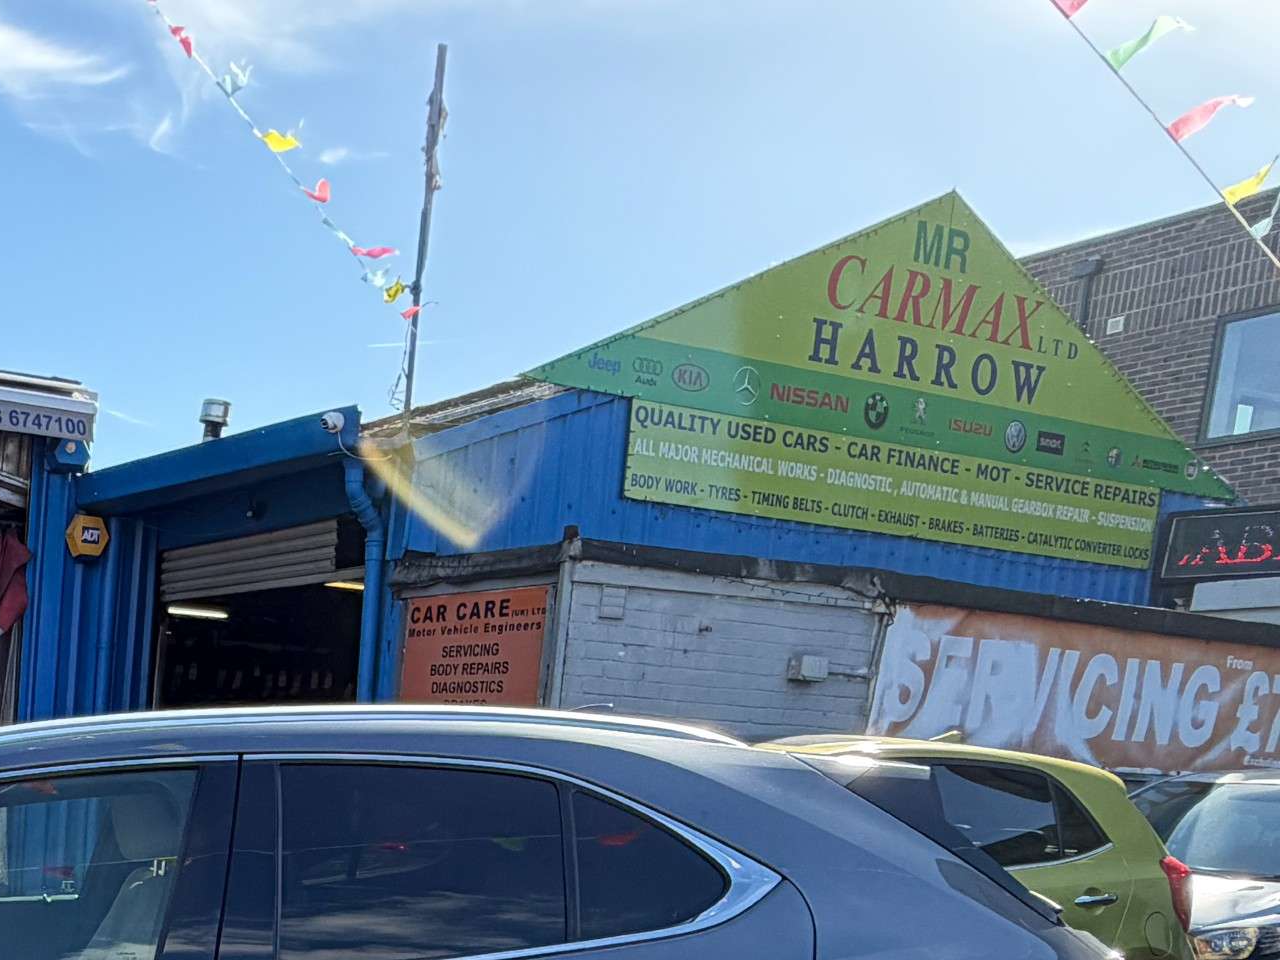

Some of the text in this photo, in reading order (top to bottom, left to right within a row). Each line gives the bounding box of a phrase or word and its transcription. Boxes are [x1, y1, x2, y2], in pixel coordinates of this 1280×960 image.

[913, 220, 970, 274] MR
[827, 254, 1079, 360] CARMAX LTD
[588, 353, 621, 376] Jeep
[808, 317, 1047, 405] HARROW
[634, 374, 658, 387] Audi
[677, 368, 704, 388] KIA
[771, 382, 850, 414] NISSAN
[8, 409, 87, 436] 6747100
[949, 418, 993, 437] ISUZU
[634, 405, 721, 435] QUALITY
[727, 420, 776, 444] USED
[782, 430, 830, 454] CARS
[847, 441, 881, 463] CAR
[886, 448, 960, 476] FINANCE
[976, 463, 1011, 483] MOT
[1024, 472, 1090, 497] SERVICE
[1093, 483, 1157, 508] REPAIRS
[634, 437, 656, 457] ALL
[659, 441, 699, 464] MAJOR
[701, 448, 774, 475] MECHANICAL
[777, 460, 818, 482] WORKS
[900, 480, 959, 503] AUTOMATIC
[960, 490, 968, 505] &
[970, 492, 1009, 512] MANUAL
[1011, 498, 1055, 517] GEARBOX
[1055, 505, 1089, 524] REPAIR
[1097, 511, 1154, 533] SUSPENSION
[630, 473, 662, 490] BODY
[664, 476, 698, 496] WORK
[708, 484, 741, 502] TYRES
[751, 490, 790, 510] TIMING
[792, 496, 822, 514] BELTS
[831, 502, 869, 521] CLUTCH
[877, 509, 920, 528] EXHAUST
[928, 517, 964, 534] BRAKES
[972, 523, 1020, 542] BATTERIES
[1027, 531, 1073, 551] CATALYTIC
[1074, 538, 1123, 557] CONVERTER
[1124, 545, 1150, 561] LOCKS
[82, 528, 101, 543] ADT
[410, 604, 448, 624] CAR
[456, 598, 511, 621] CARE
[531, 607, 547, 616] LTD
[408, 620, 542, 638] Motor Vehicle Engineers
[441, 642, 500, 659] SERVICING
[1226, 655, 1254, 670] From
[430, 661, 510, 677] BODY REPAIRS
[431, 680, 504, 694] DIAGNOSTICS
[872, 628, 1221, 748] SERVICING
